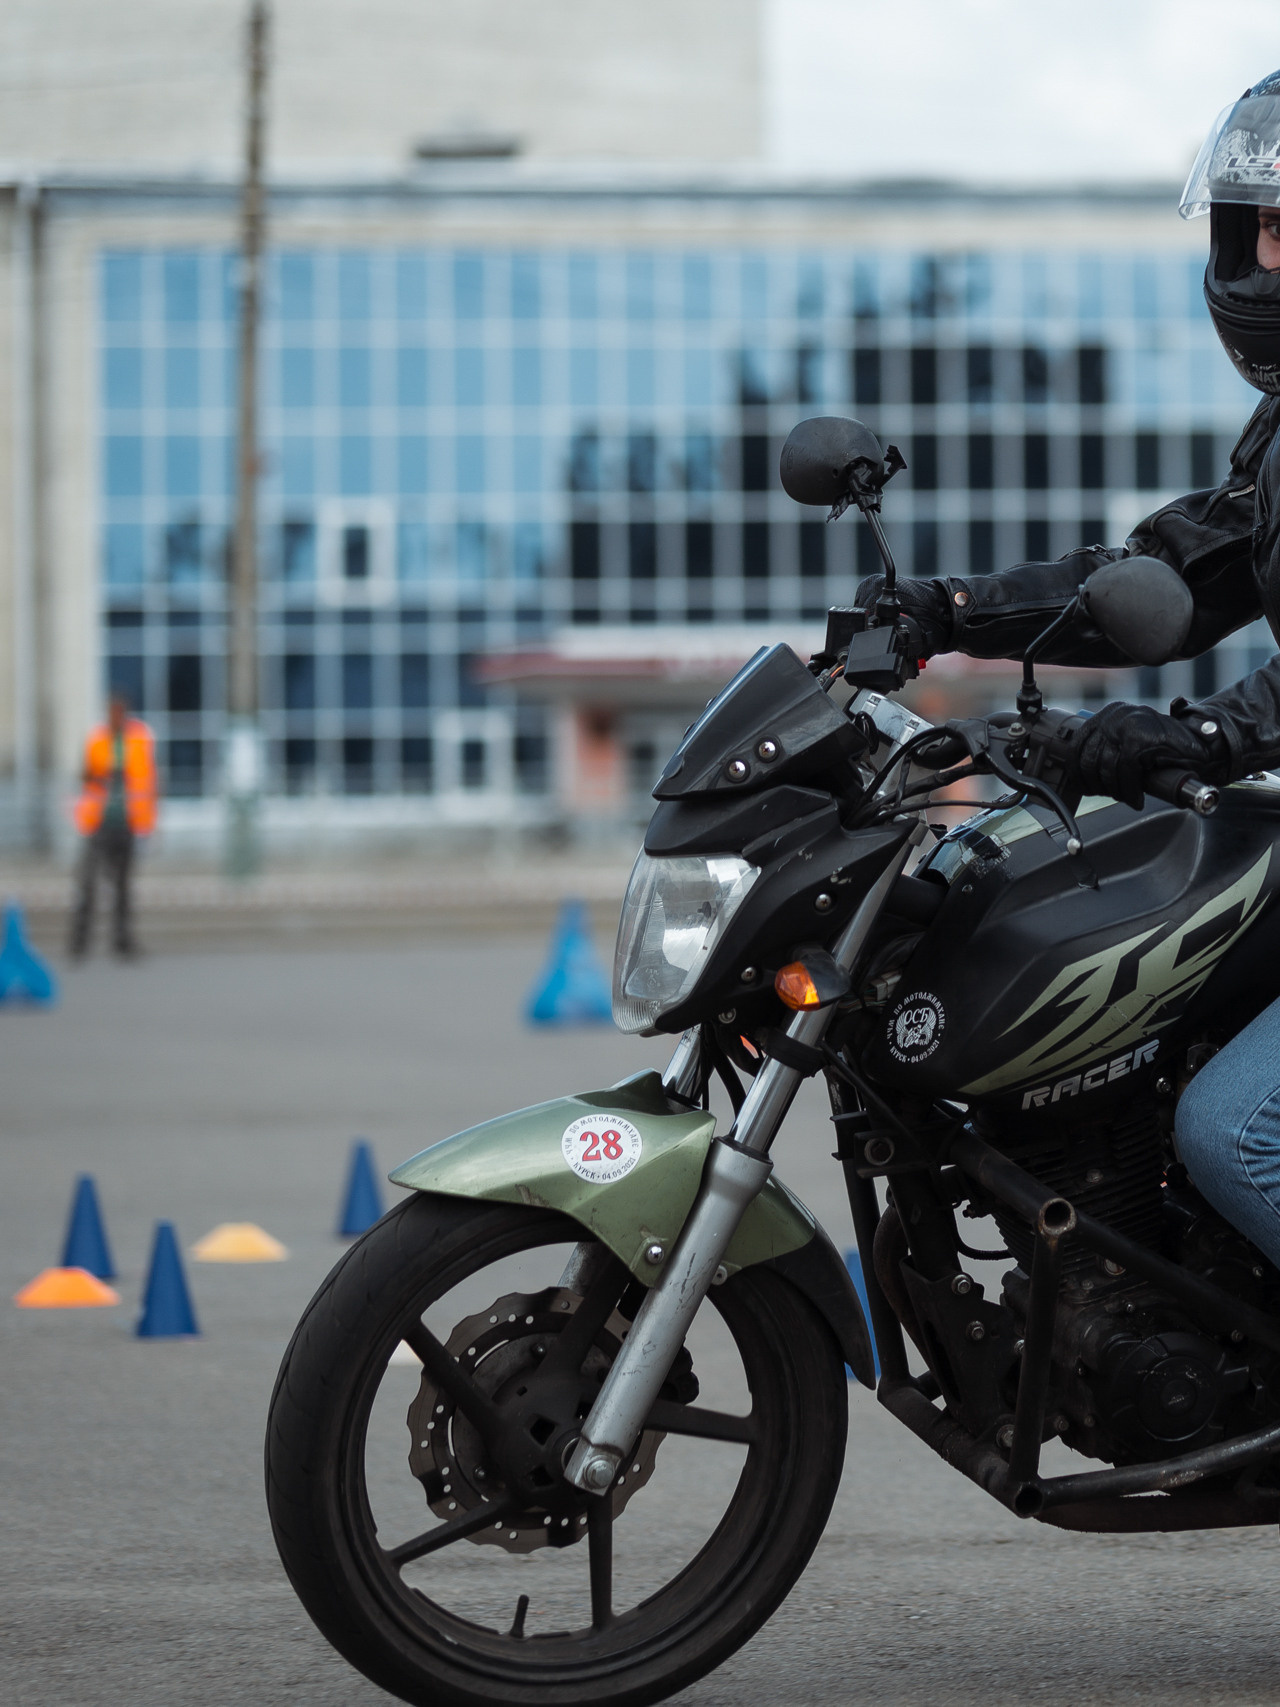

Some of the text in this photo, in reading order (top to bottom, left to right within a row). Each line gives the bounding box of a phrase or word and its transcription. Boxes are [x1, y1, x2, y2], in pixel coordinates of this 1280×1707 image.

[1021, 1038, 1160, 1111] RACER
[579, 1129, 624, 1162] 28
[573, 1157, 636, 1180] КУРСК 04.09.2021
